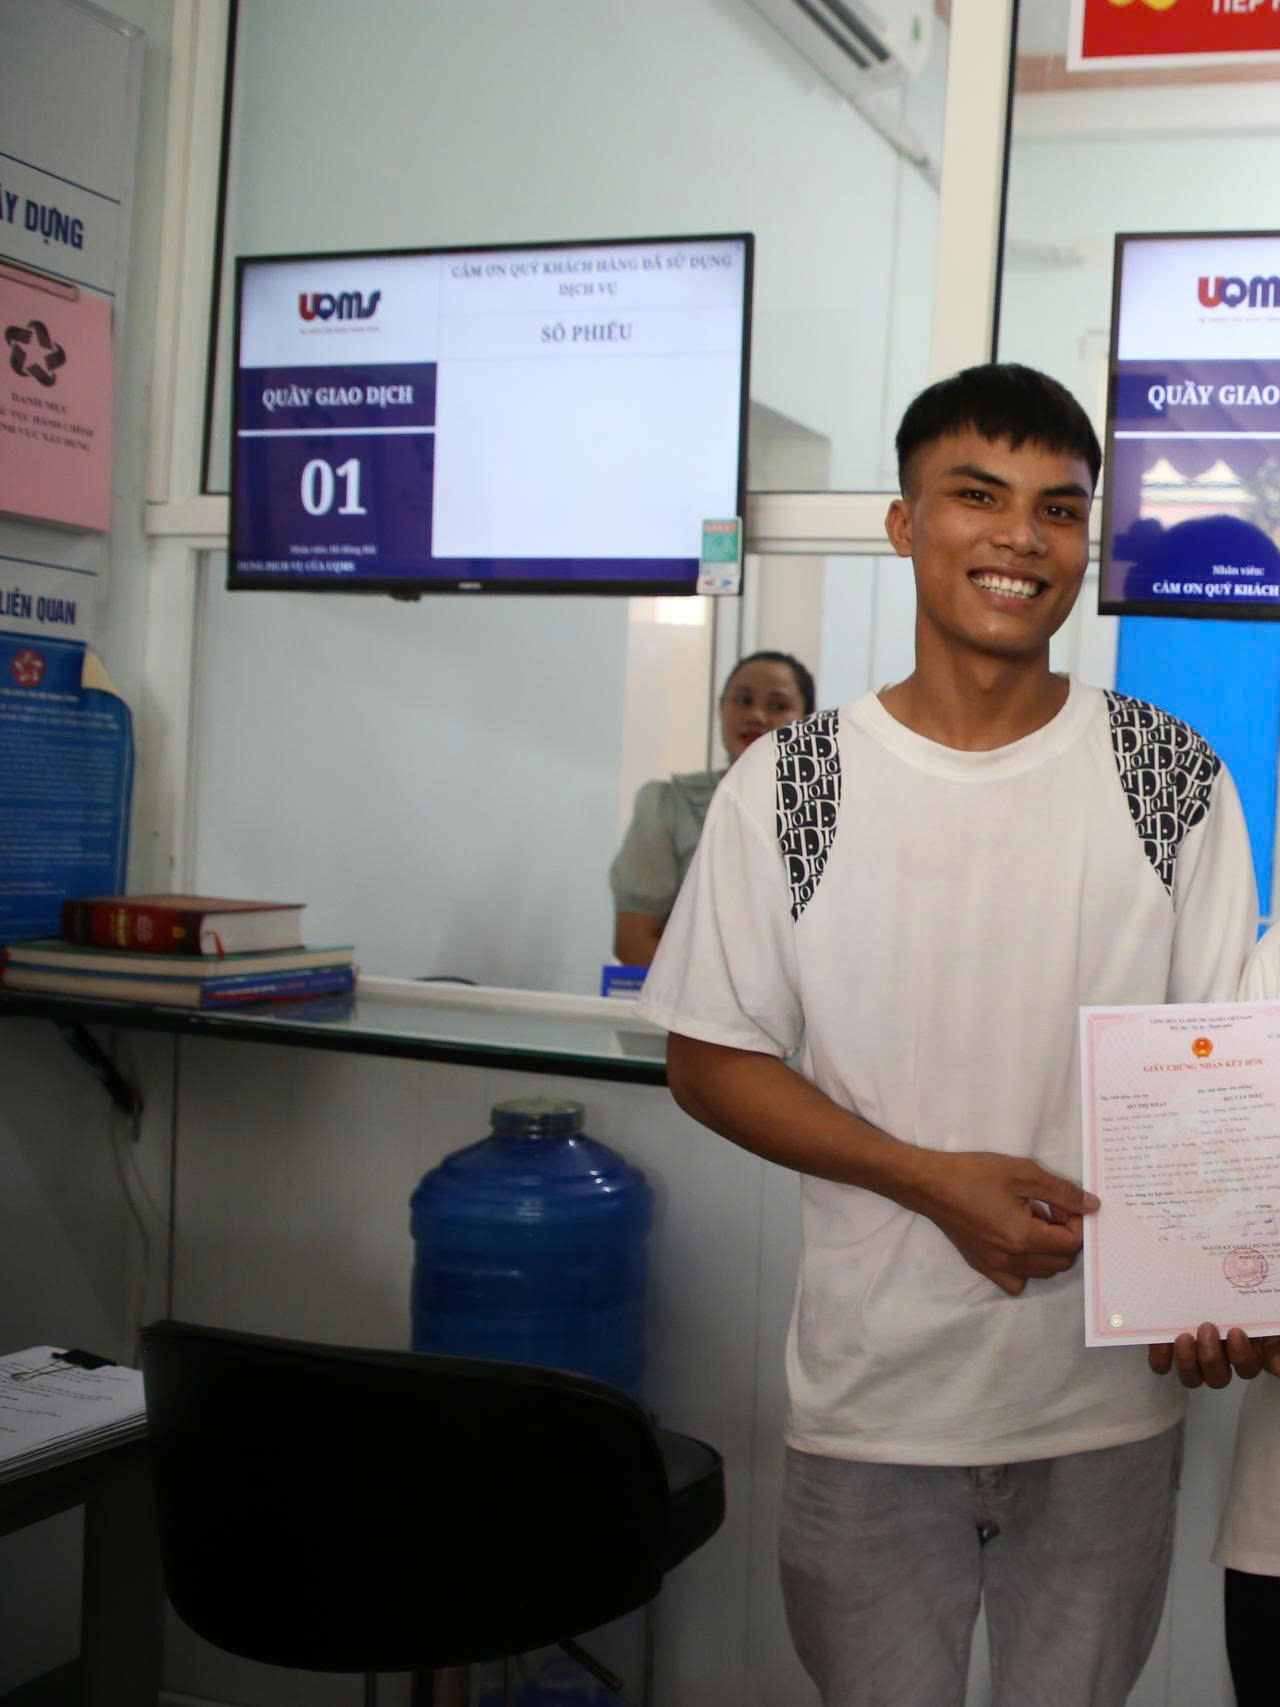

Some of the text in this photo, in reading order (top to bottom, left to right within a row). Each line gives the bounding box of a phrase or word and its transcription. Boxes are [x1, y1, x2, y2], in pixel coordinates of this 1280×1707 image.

[25, 199, 83, 250] DỰNG
[541, 321, 566, 343] SỐ
[262, 383, 415, 412] QUẦY GIAO DỊCH
[1147, 378, 1215, 412] QUẦY
[1218, 384, 1280, 406] GIAO
[300, 458, 367, 516] 01
[37, 596, 77, 625] QUAN
